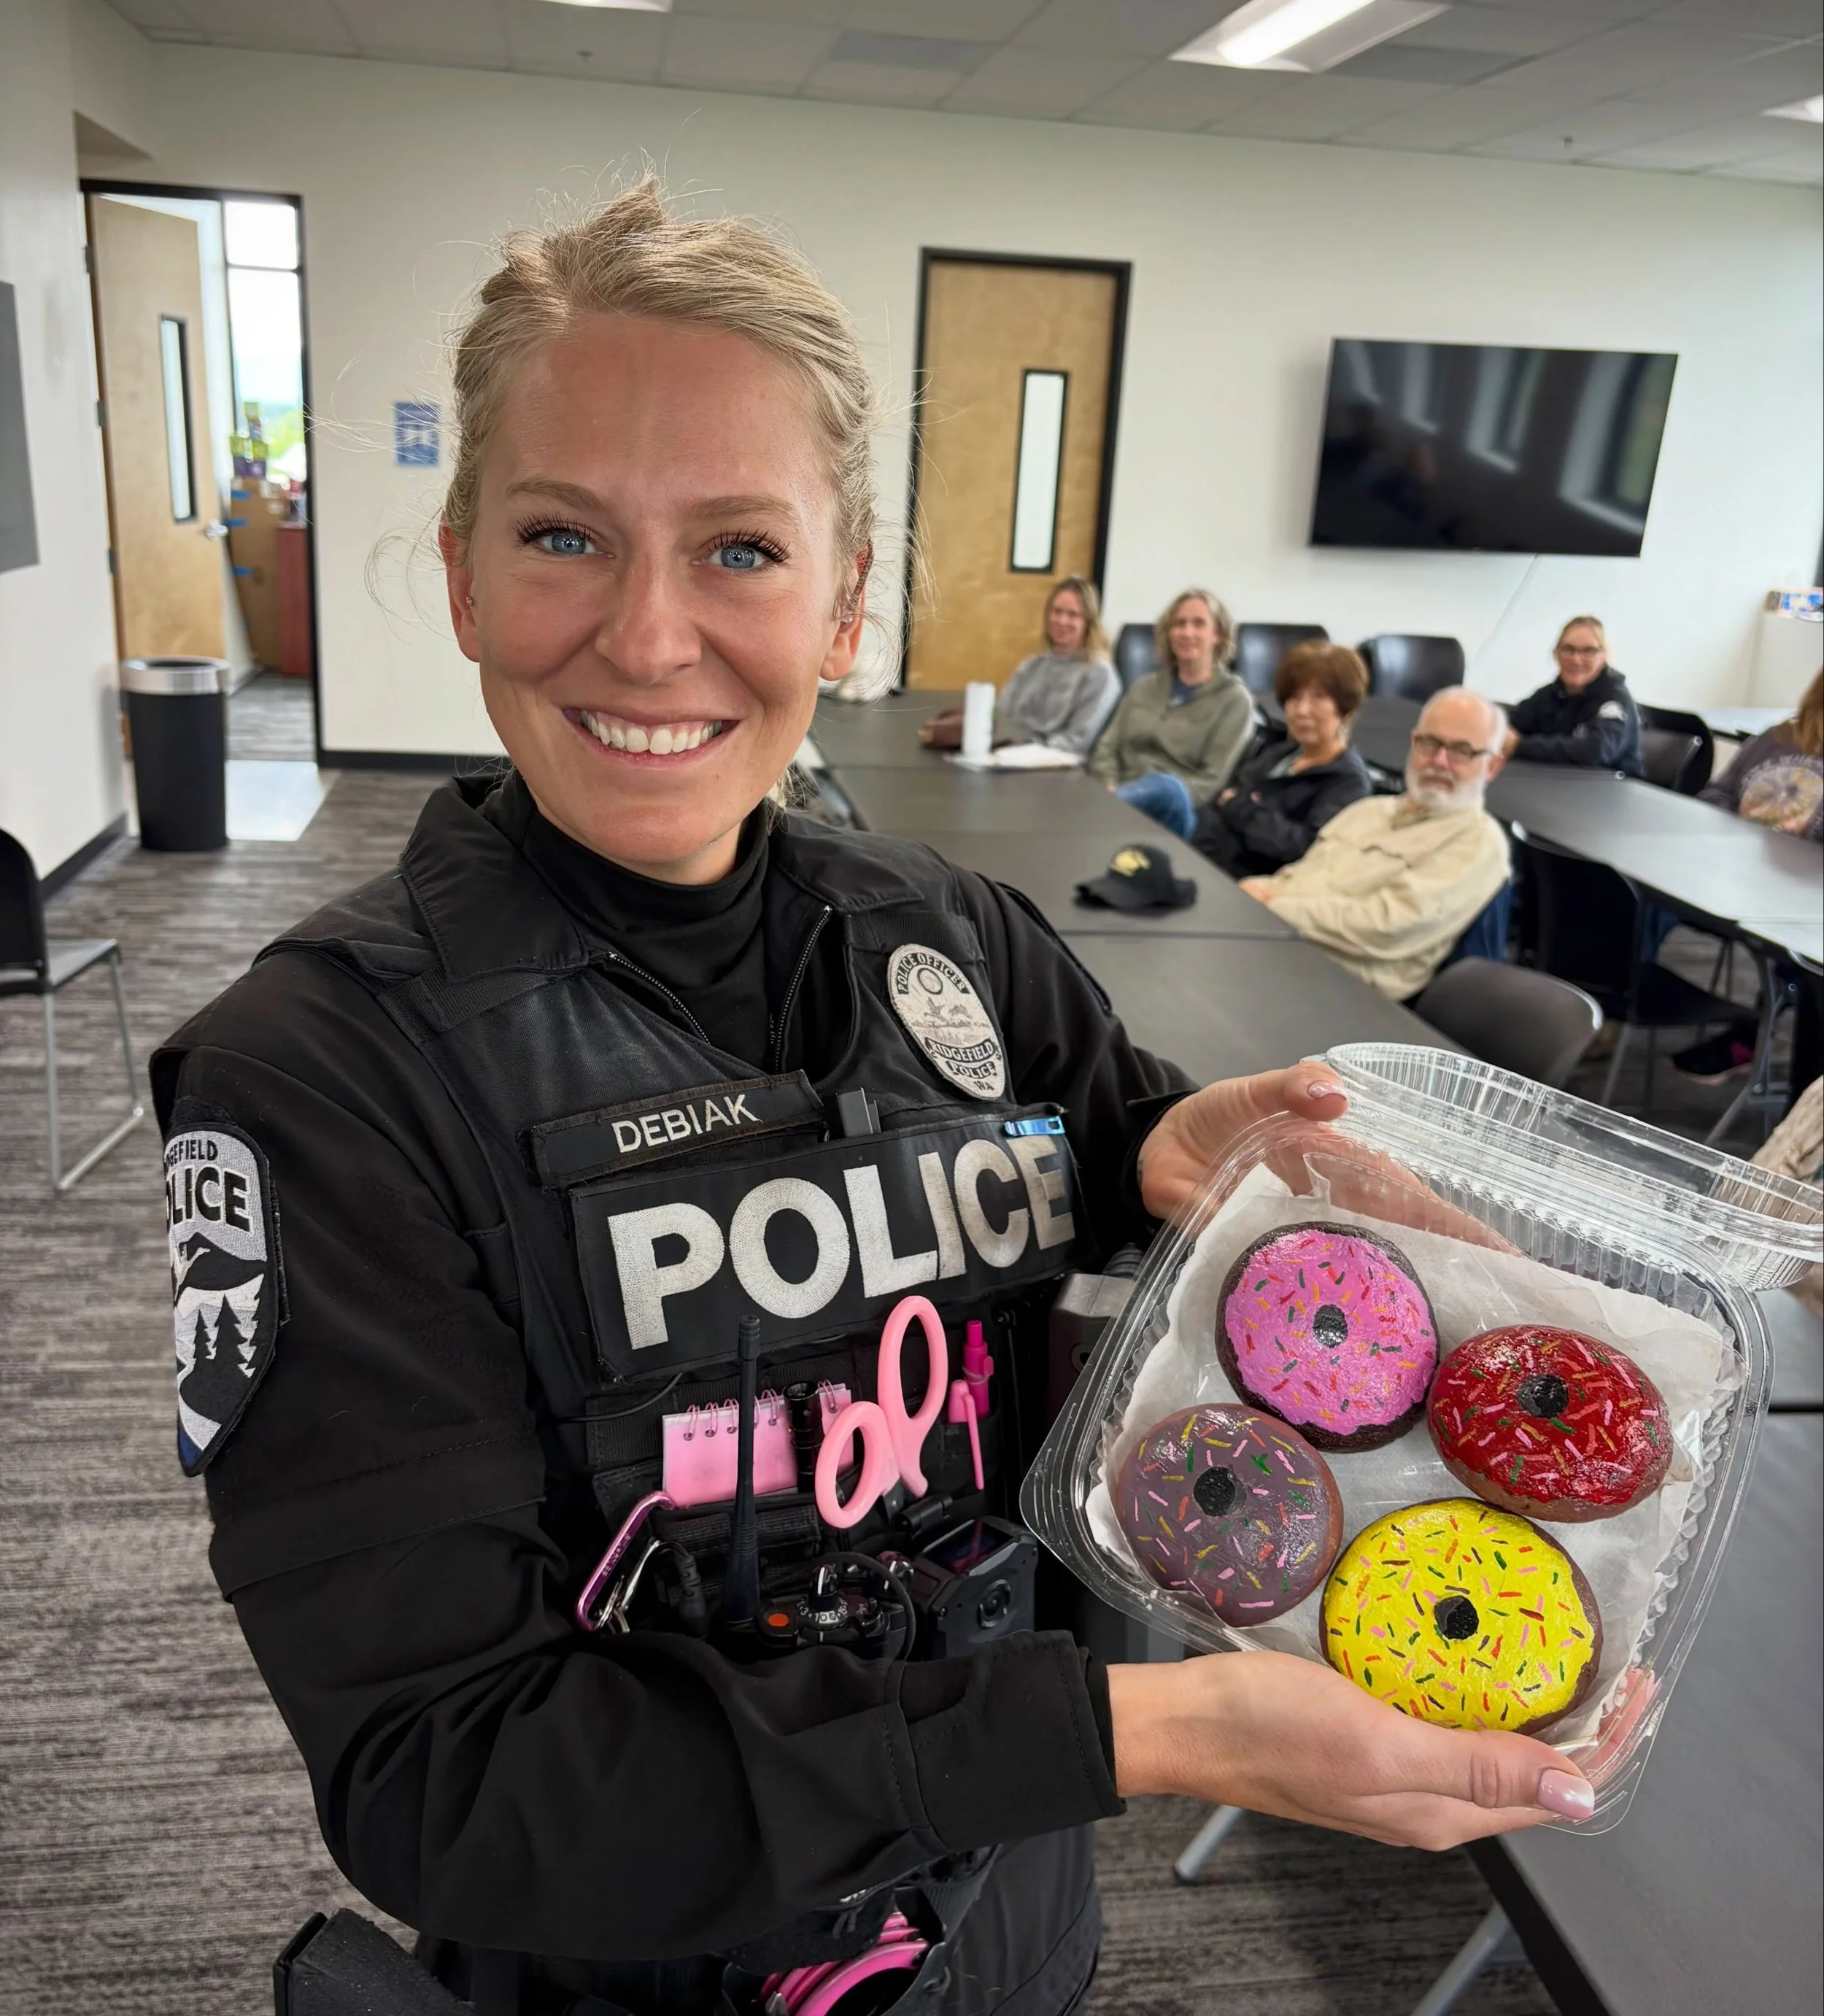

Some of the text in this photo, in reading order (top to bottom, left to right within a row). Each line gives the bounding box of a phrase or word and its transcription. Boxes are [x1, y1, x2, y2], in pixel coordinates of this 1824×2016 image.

[898, 952, 967, 992] POLICE OFFICER
[929, 1039, 994, 1061] RIDGEFIELD
[951, 1061, 994, 1078] POLICE
[611, 1094, 762, 1153] DEBIAK
[166, 1139, 218, 1168] GEFIELD
[607, 1135, 1075, 1351] POLICE
